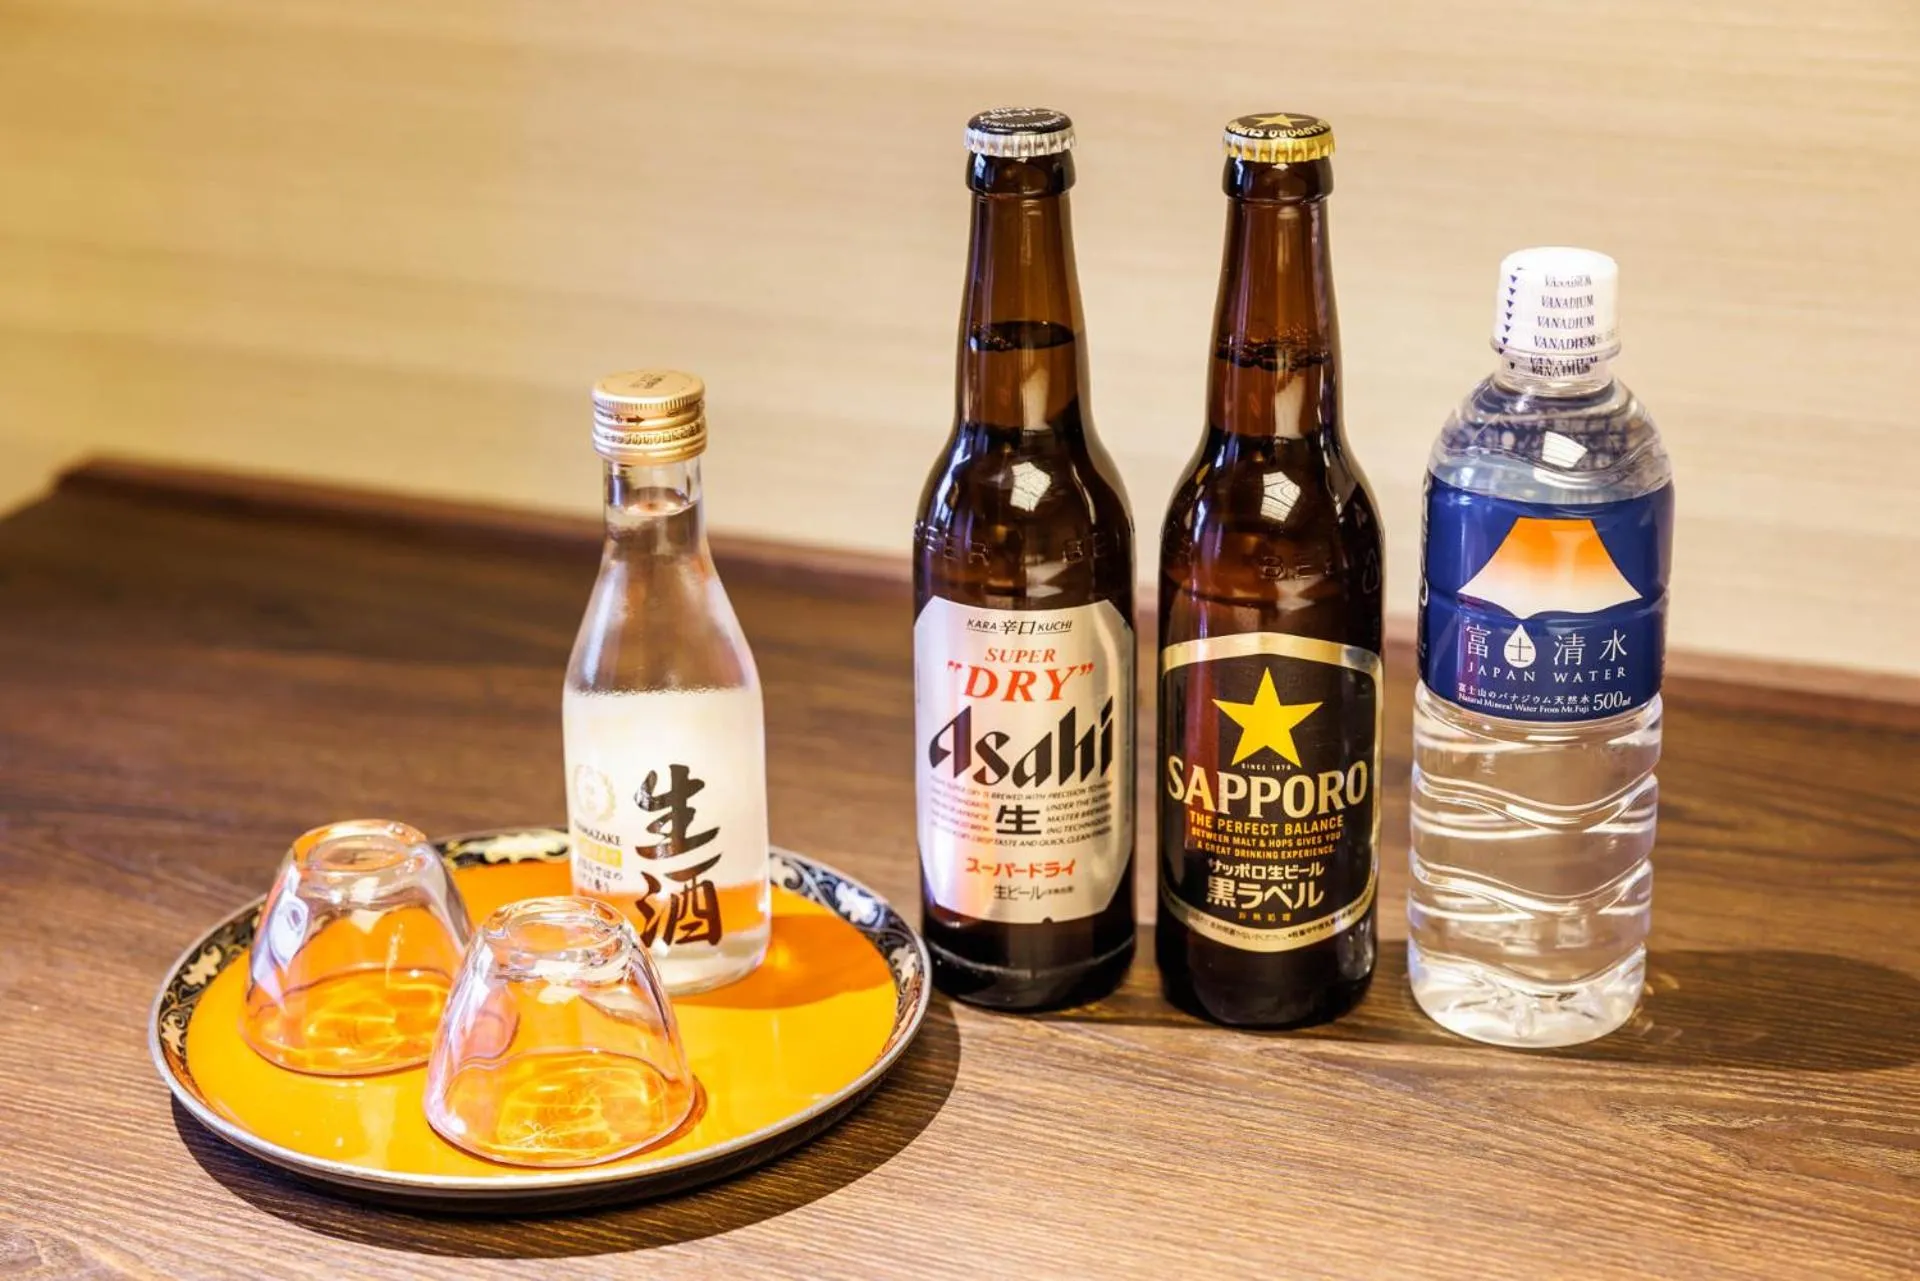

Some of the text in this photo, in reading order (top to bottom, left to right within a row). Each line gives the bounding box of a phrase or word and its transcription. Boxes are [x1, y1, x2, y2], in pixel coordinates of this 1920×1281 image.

[1541, 294, 1594, 309] VANADIUM
[1537, 315, 1595, 329] VANADIUM
[1534, 335, 1596, 350] VANADIUM
[966, 618, 1073, 635] KARA 辛口 KUCHI
[984, 647, 1057, 663] SUPER
[1467, 661, 1627, 683] JAPAN WATER
[1458, 682, 1590, 705] 富士山のバナジウム天然水
[1484, 700, 1513, 710] Mineral
[1515, 703, 1538, 712] Water
[1540, 705, 1560, 713] From
[929, 696, 1113, 788] Asahi
[1241, 763, 1267, 772] SINCE
[1167, 755, 1368, 818] SAPPORO
[996, 805, 1041, 835] 生
[1189, 811, 1344, 836] THE PERFECT BALANCE
[1191, 827, 1341, 848] BETWEEN MALT & HOPS GIVES YOU
[633, 764, 723, 948] 生酒
[1205, 842, 1231, 856] GREAT
[1234, 848, 1279, 859] DRINKING
[965, 857, 1076, 879] スーパードライ
[1208, 858, 1325, 880] サッポロ生ビール
[993, 884, 1047, 901] 生ビール
[1206, 875, 1325, 910] 黒ラベル
